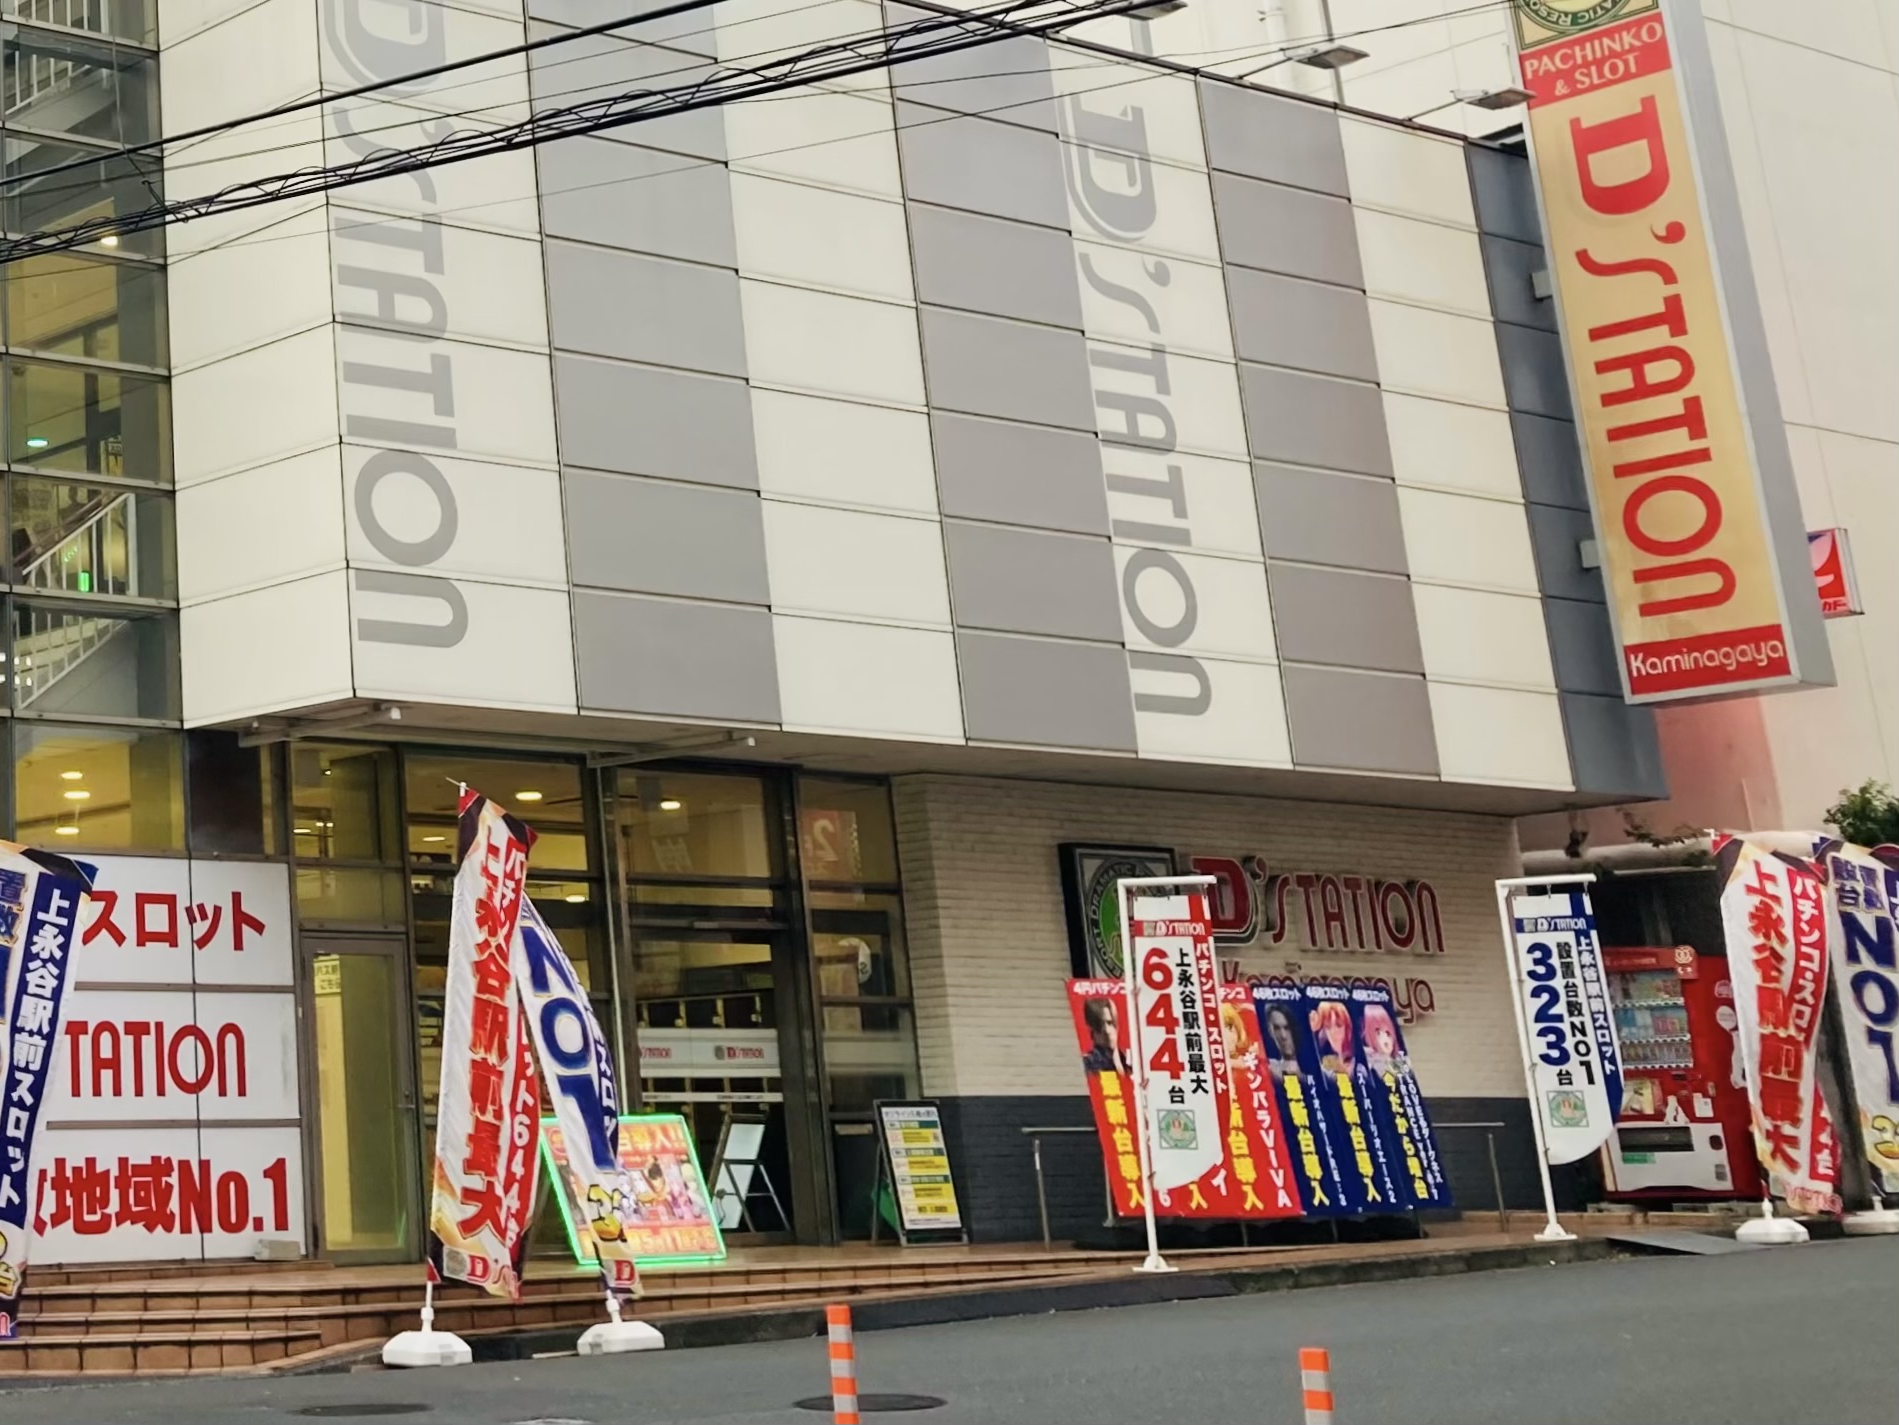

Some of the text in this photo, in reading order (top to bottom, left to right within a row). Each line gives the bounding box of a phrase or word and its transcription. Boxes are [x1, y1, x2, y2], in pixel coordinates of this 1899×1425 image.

[1523, 21, 1663, 80] PACHINKO
[1553, 51, 1641, 97] & SLOT
[1568, 93, 1738, 618] D'STATION
[1628, 637, 1785, 683] Kaminagaya
[1191, 855, 1446, 954] D'STATION
[64, 1020, 248, 1098] TATION
[1175, 947, 1210, 1096] 上永谷駅前最大
